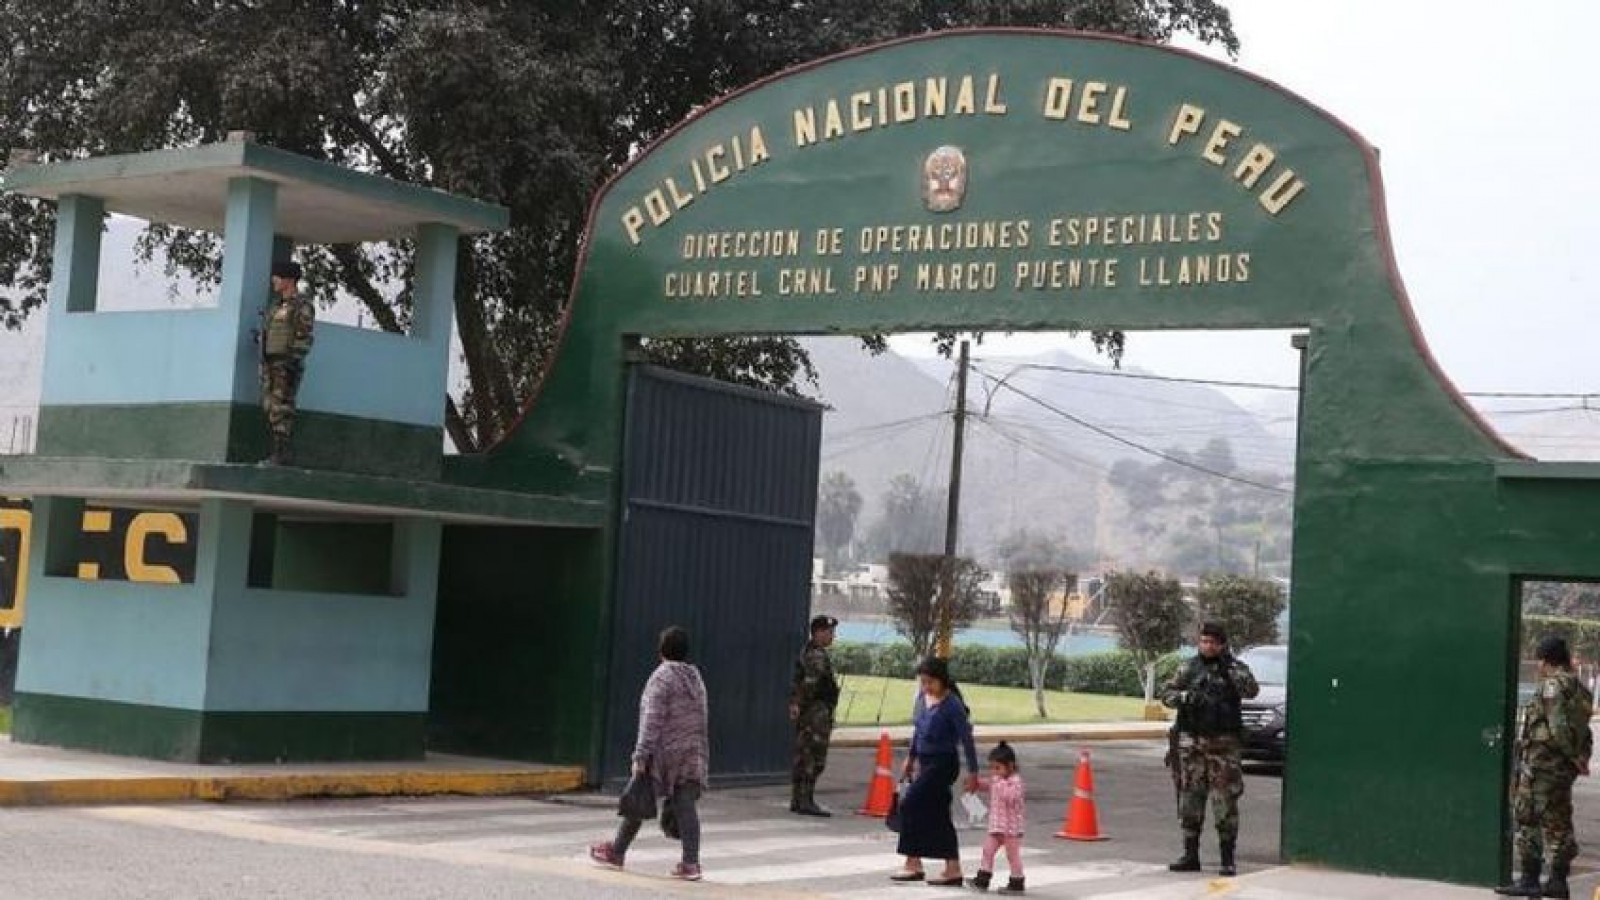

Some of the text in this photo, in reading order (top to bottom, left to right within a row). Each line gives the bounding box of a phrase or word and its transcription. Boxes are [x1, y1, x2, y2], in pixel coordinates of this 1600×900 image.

[621, 73, 1305, 246] POLICIA NACIONAL DEL PERU
[683, 212, 1222, 259] DIRECCION DE OPERACIONES ESPECIALES
[665, 252, 1250, 298] CUARTEL CRNL PNP MARCO PUENTE LLANOS
